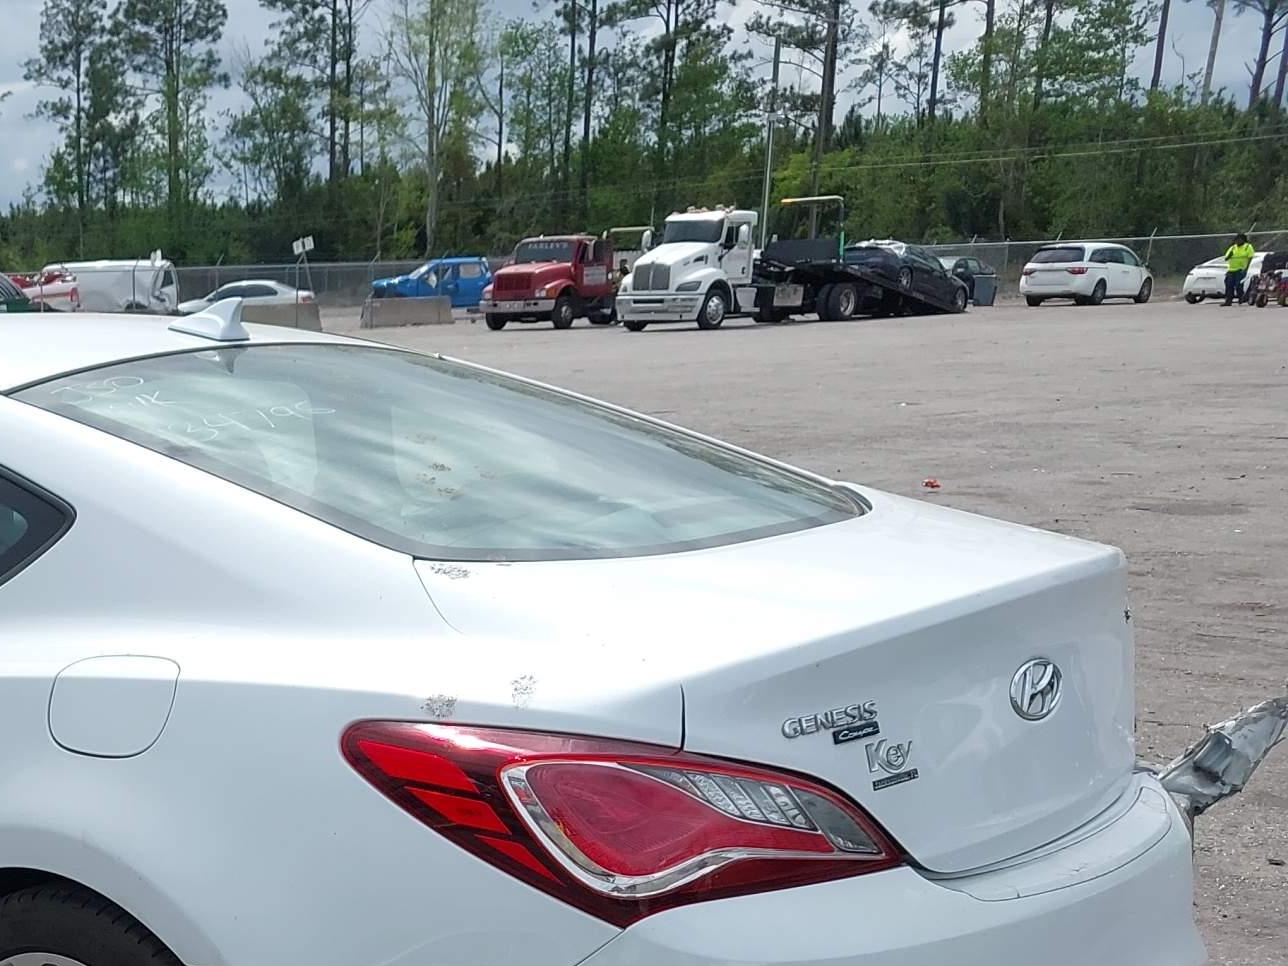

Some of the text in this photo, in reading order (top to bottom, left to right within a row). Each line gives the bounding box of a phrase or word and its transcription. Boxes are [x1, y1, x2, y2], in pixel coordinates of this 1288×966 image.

[782, 700, 878, 739] GENESIS
[838, 725, 879, 741] Coupe
[864, 738, 912, 774] Key
